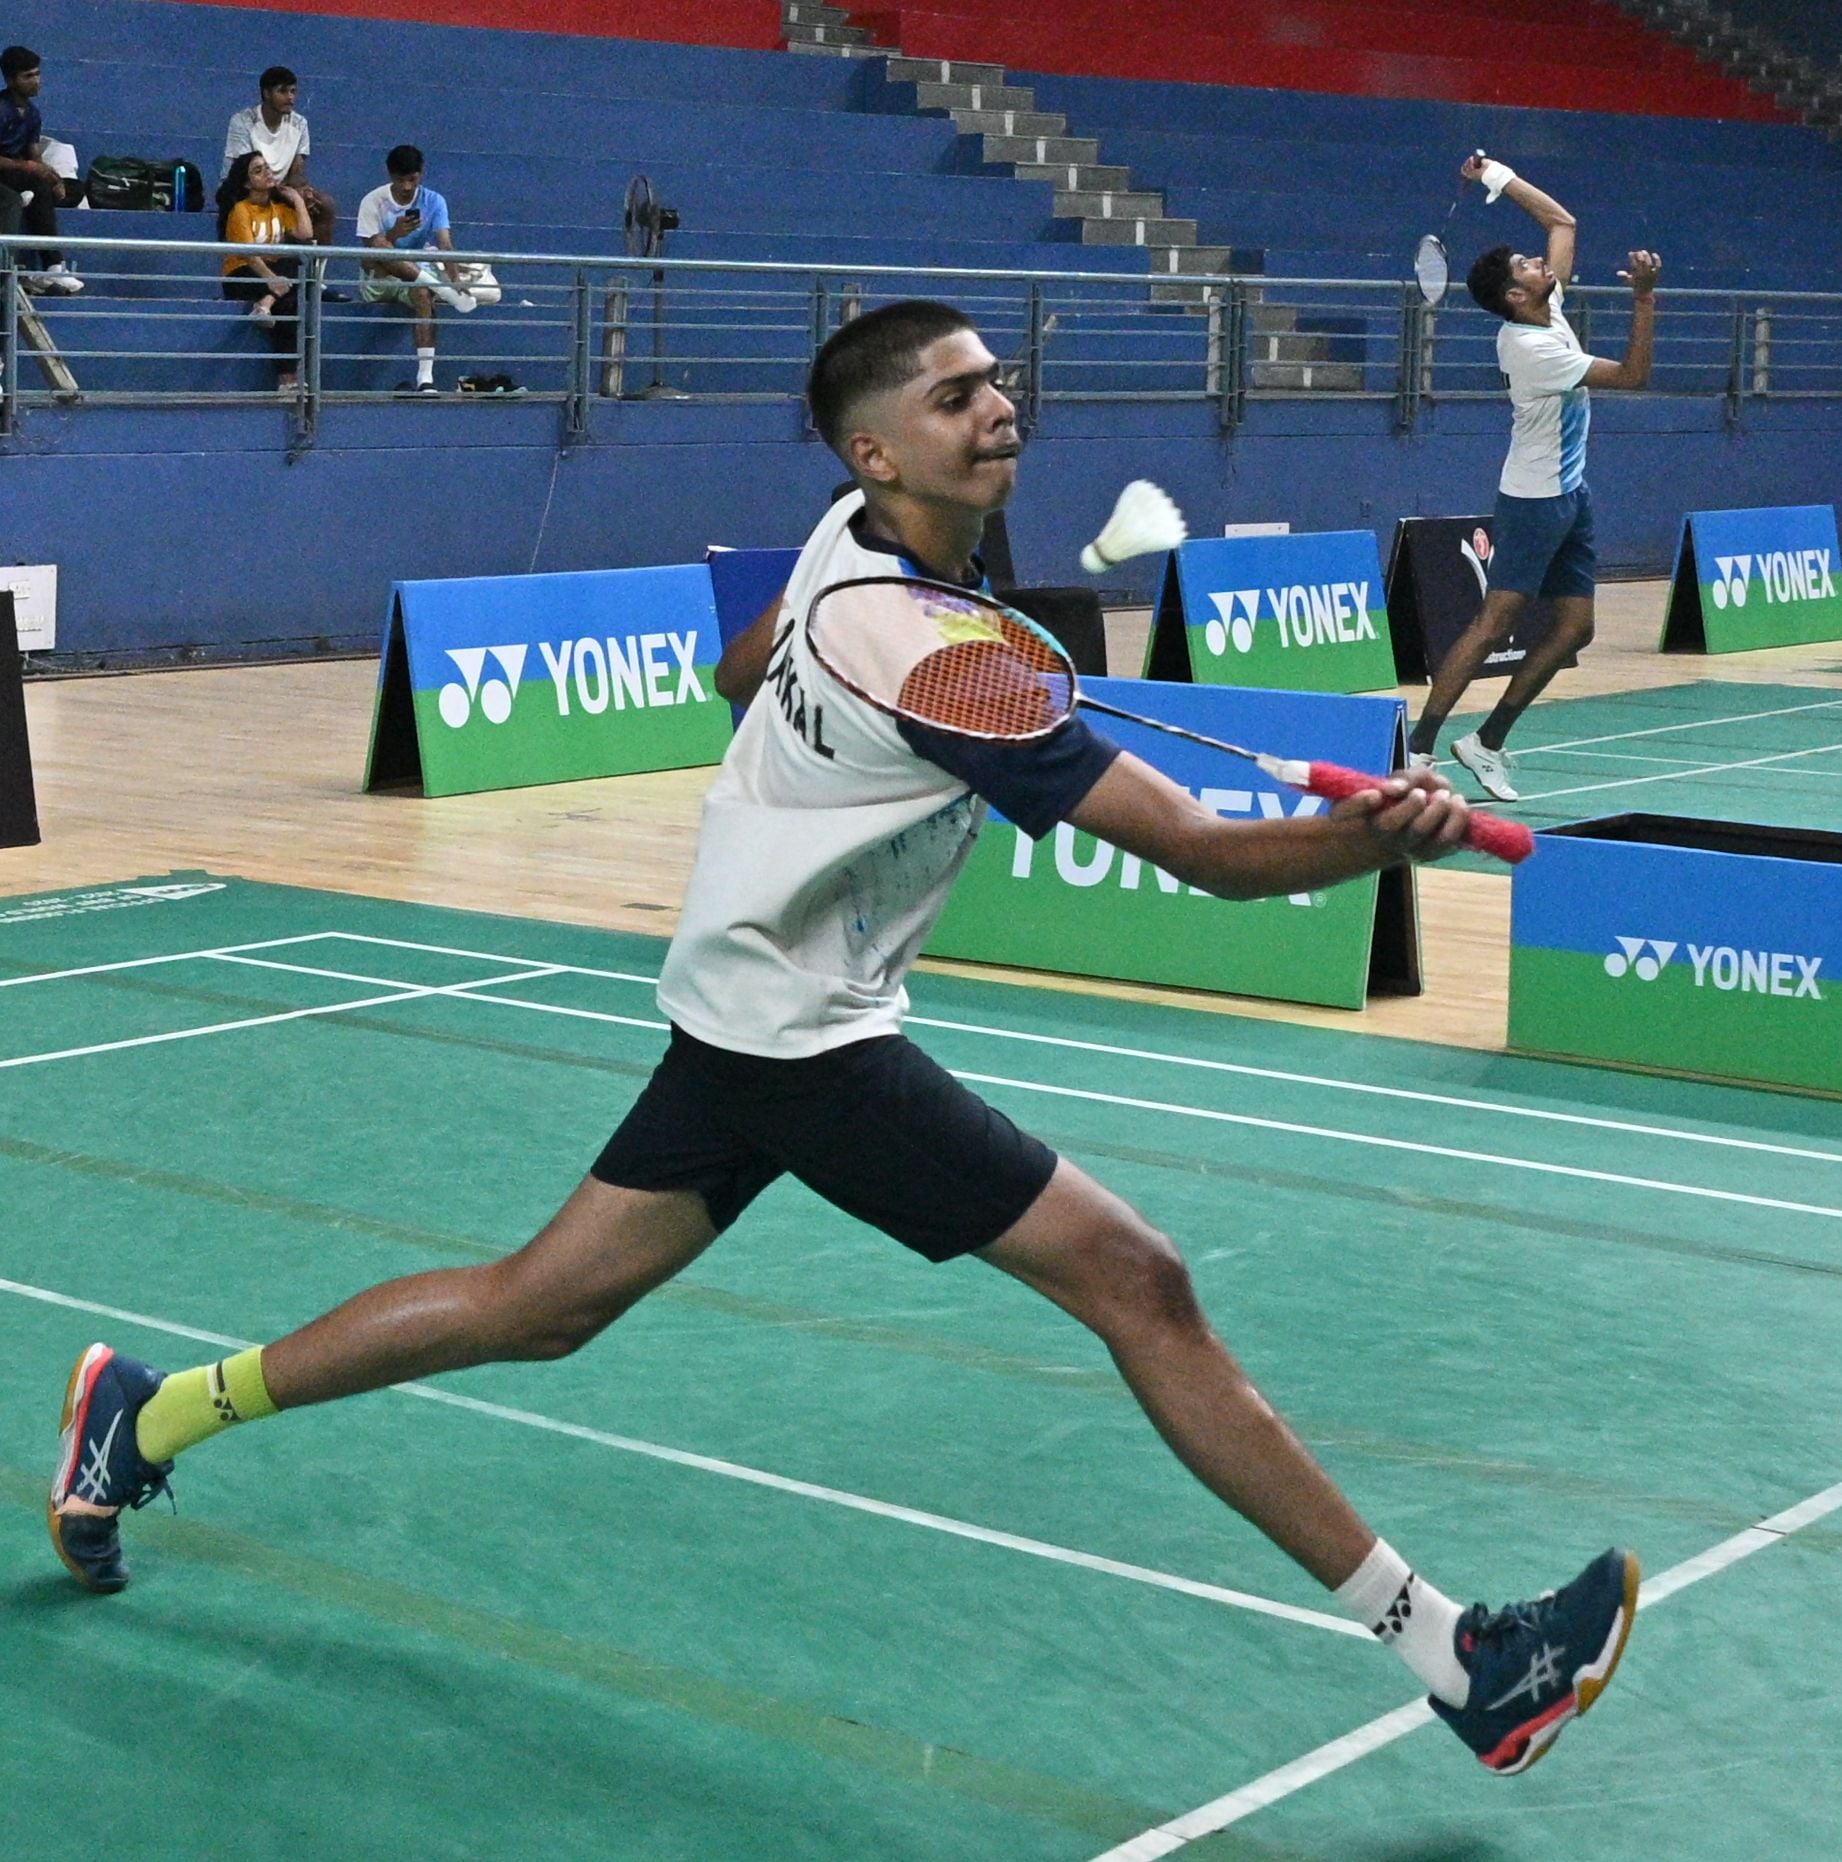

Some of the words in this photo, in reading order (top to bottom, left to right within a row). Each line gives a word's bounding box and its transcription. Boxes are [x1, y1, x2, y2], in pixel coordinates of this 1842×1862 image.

[1756, 548, 1836, 603] YONEX
[1266, 581, 1376, 648] YONEX
[538, 630, 707, 716] YONEX
[1686, 943, 1823, 1000] YONEX
